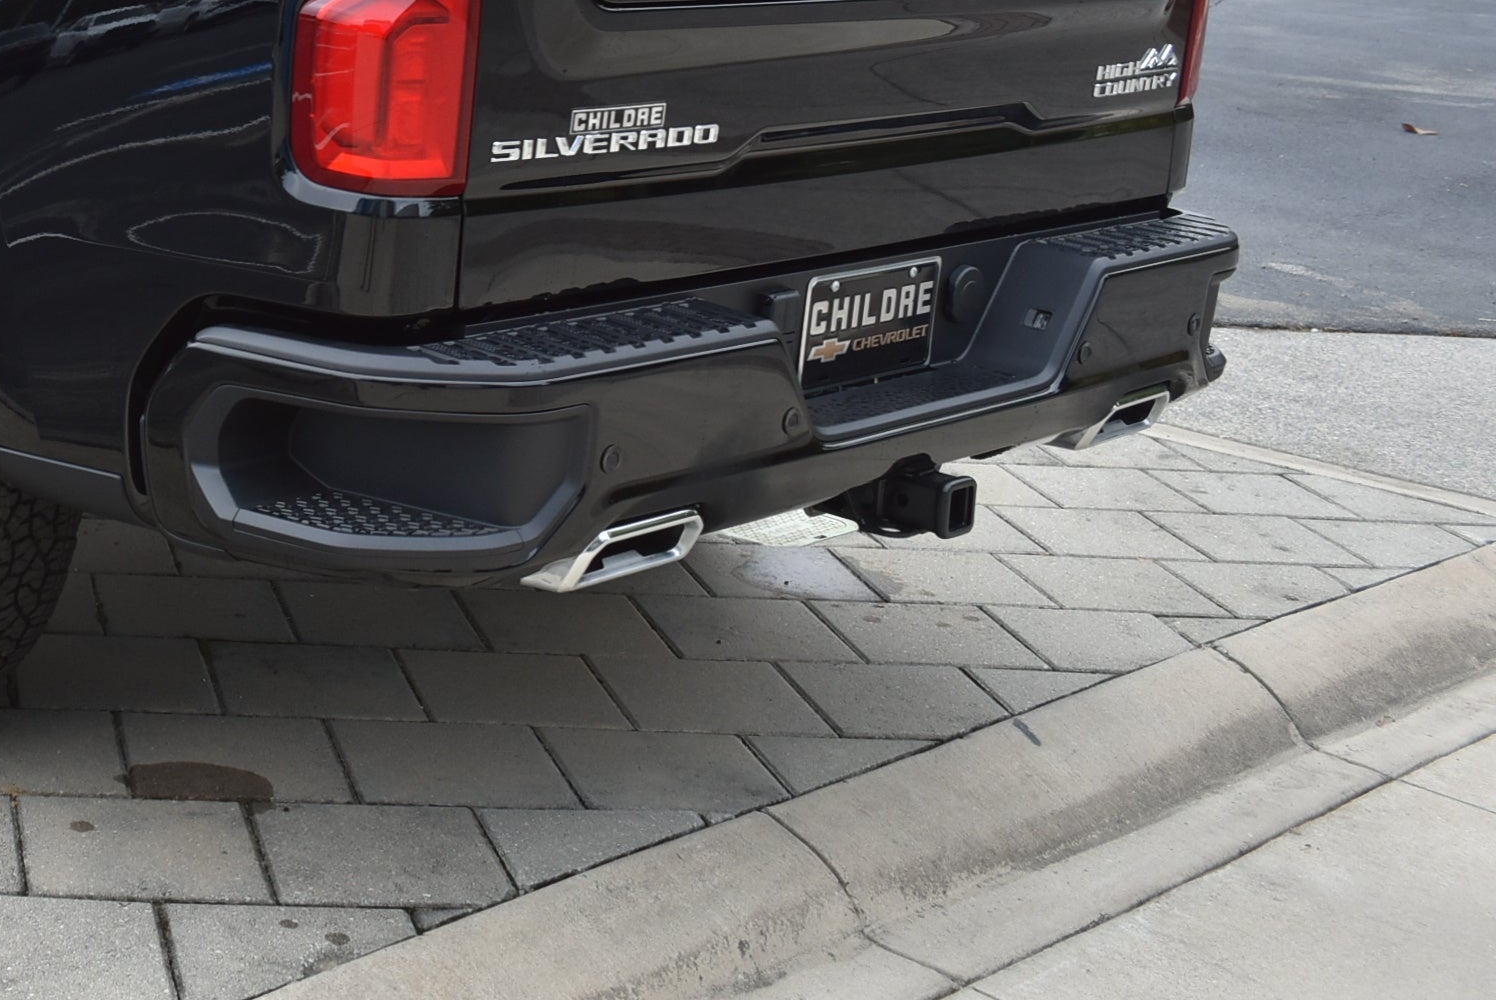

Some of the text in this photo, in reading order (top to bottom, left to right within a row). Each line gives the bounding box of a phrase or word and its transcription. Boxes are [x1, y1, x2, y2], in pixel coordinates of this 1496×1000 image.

[1096, 60, 1142, 81] HIGH
[1093, 72, 1177, 98] COUNTRY
[573, 105, 664, 132] CHILDRE
[490, 123, 720, 163] SILVERADO
[809, 280, 934, 336] CHILDRE
[852, 323, 929, 351] CHEVROLET
